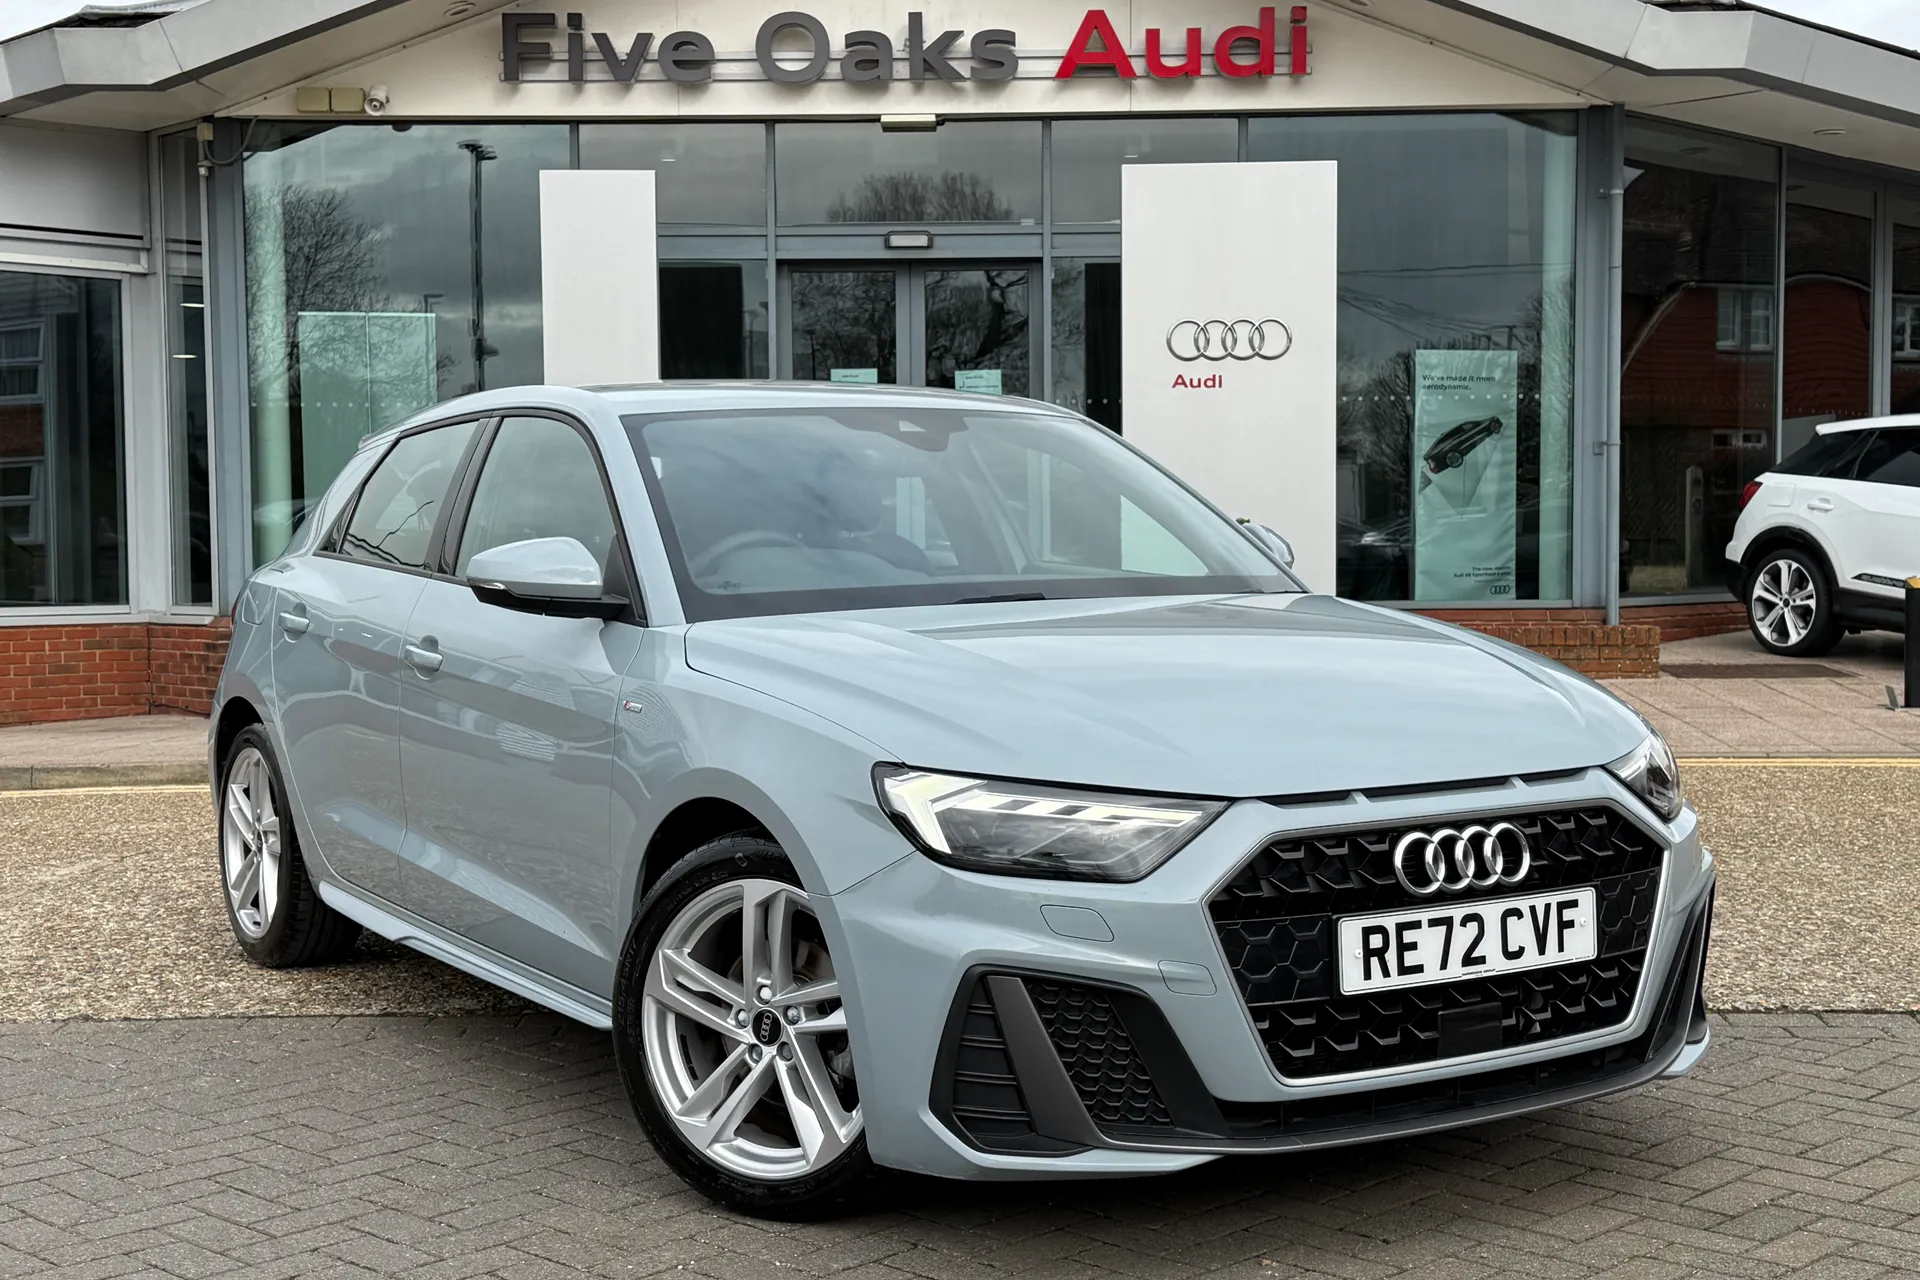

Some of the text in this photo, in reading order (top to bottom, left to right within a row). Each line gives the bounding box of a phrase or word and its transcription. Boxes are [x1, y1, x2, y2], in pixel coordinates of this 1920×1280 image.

[501, 5, 1310, 85] Five Oaks Audi
[1171, 373, 1223, 389] Audi
[1422, 374, 1445, 382] We've
[1446, 374, 1468, 382] made
[1422, 383, 1472, 391] aerodynamic.
[1361, 898, 1579, 982] RE72 CVF
